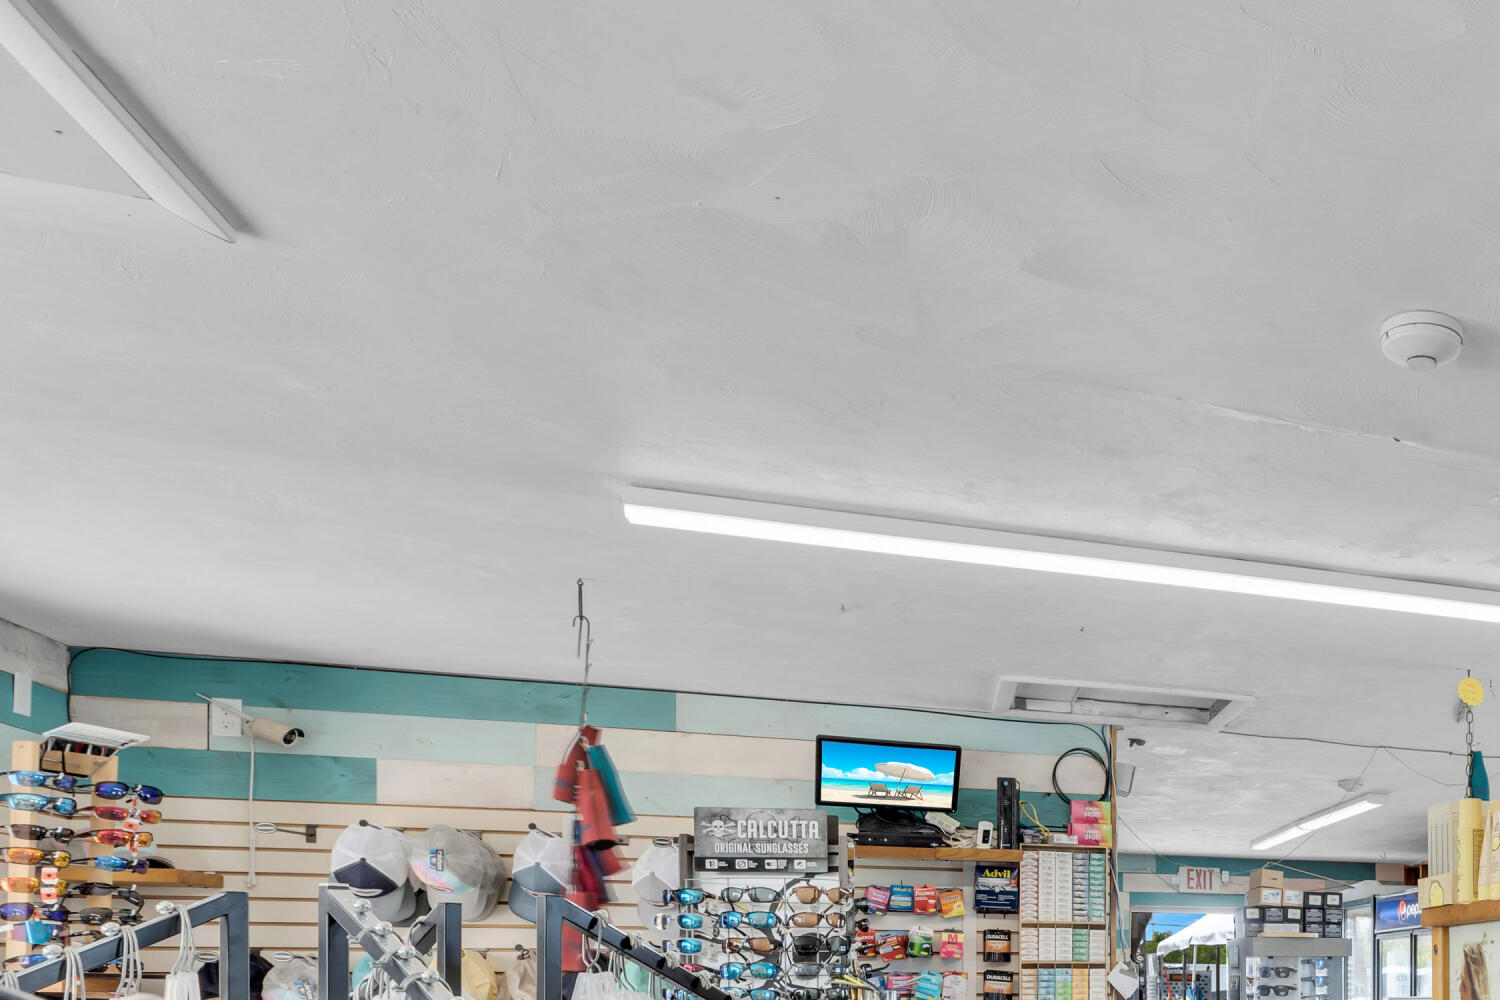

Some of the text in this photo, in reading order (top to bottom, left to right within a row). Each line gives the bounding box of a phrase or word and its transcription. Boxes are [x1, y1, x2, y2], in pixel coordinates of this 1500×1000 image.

[737, 819, 819, 839] CALCUTTA
[714, 842, 809, 854] ORIGINAL SUNGLASSES
[982, 868, 1011, 879] Advil
[1186, 868, 1214, 890] EXIT
[985, 933, 1009, 941] DURACELL
[986, 974, 1012, 982] DURACELL
